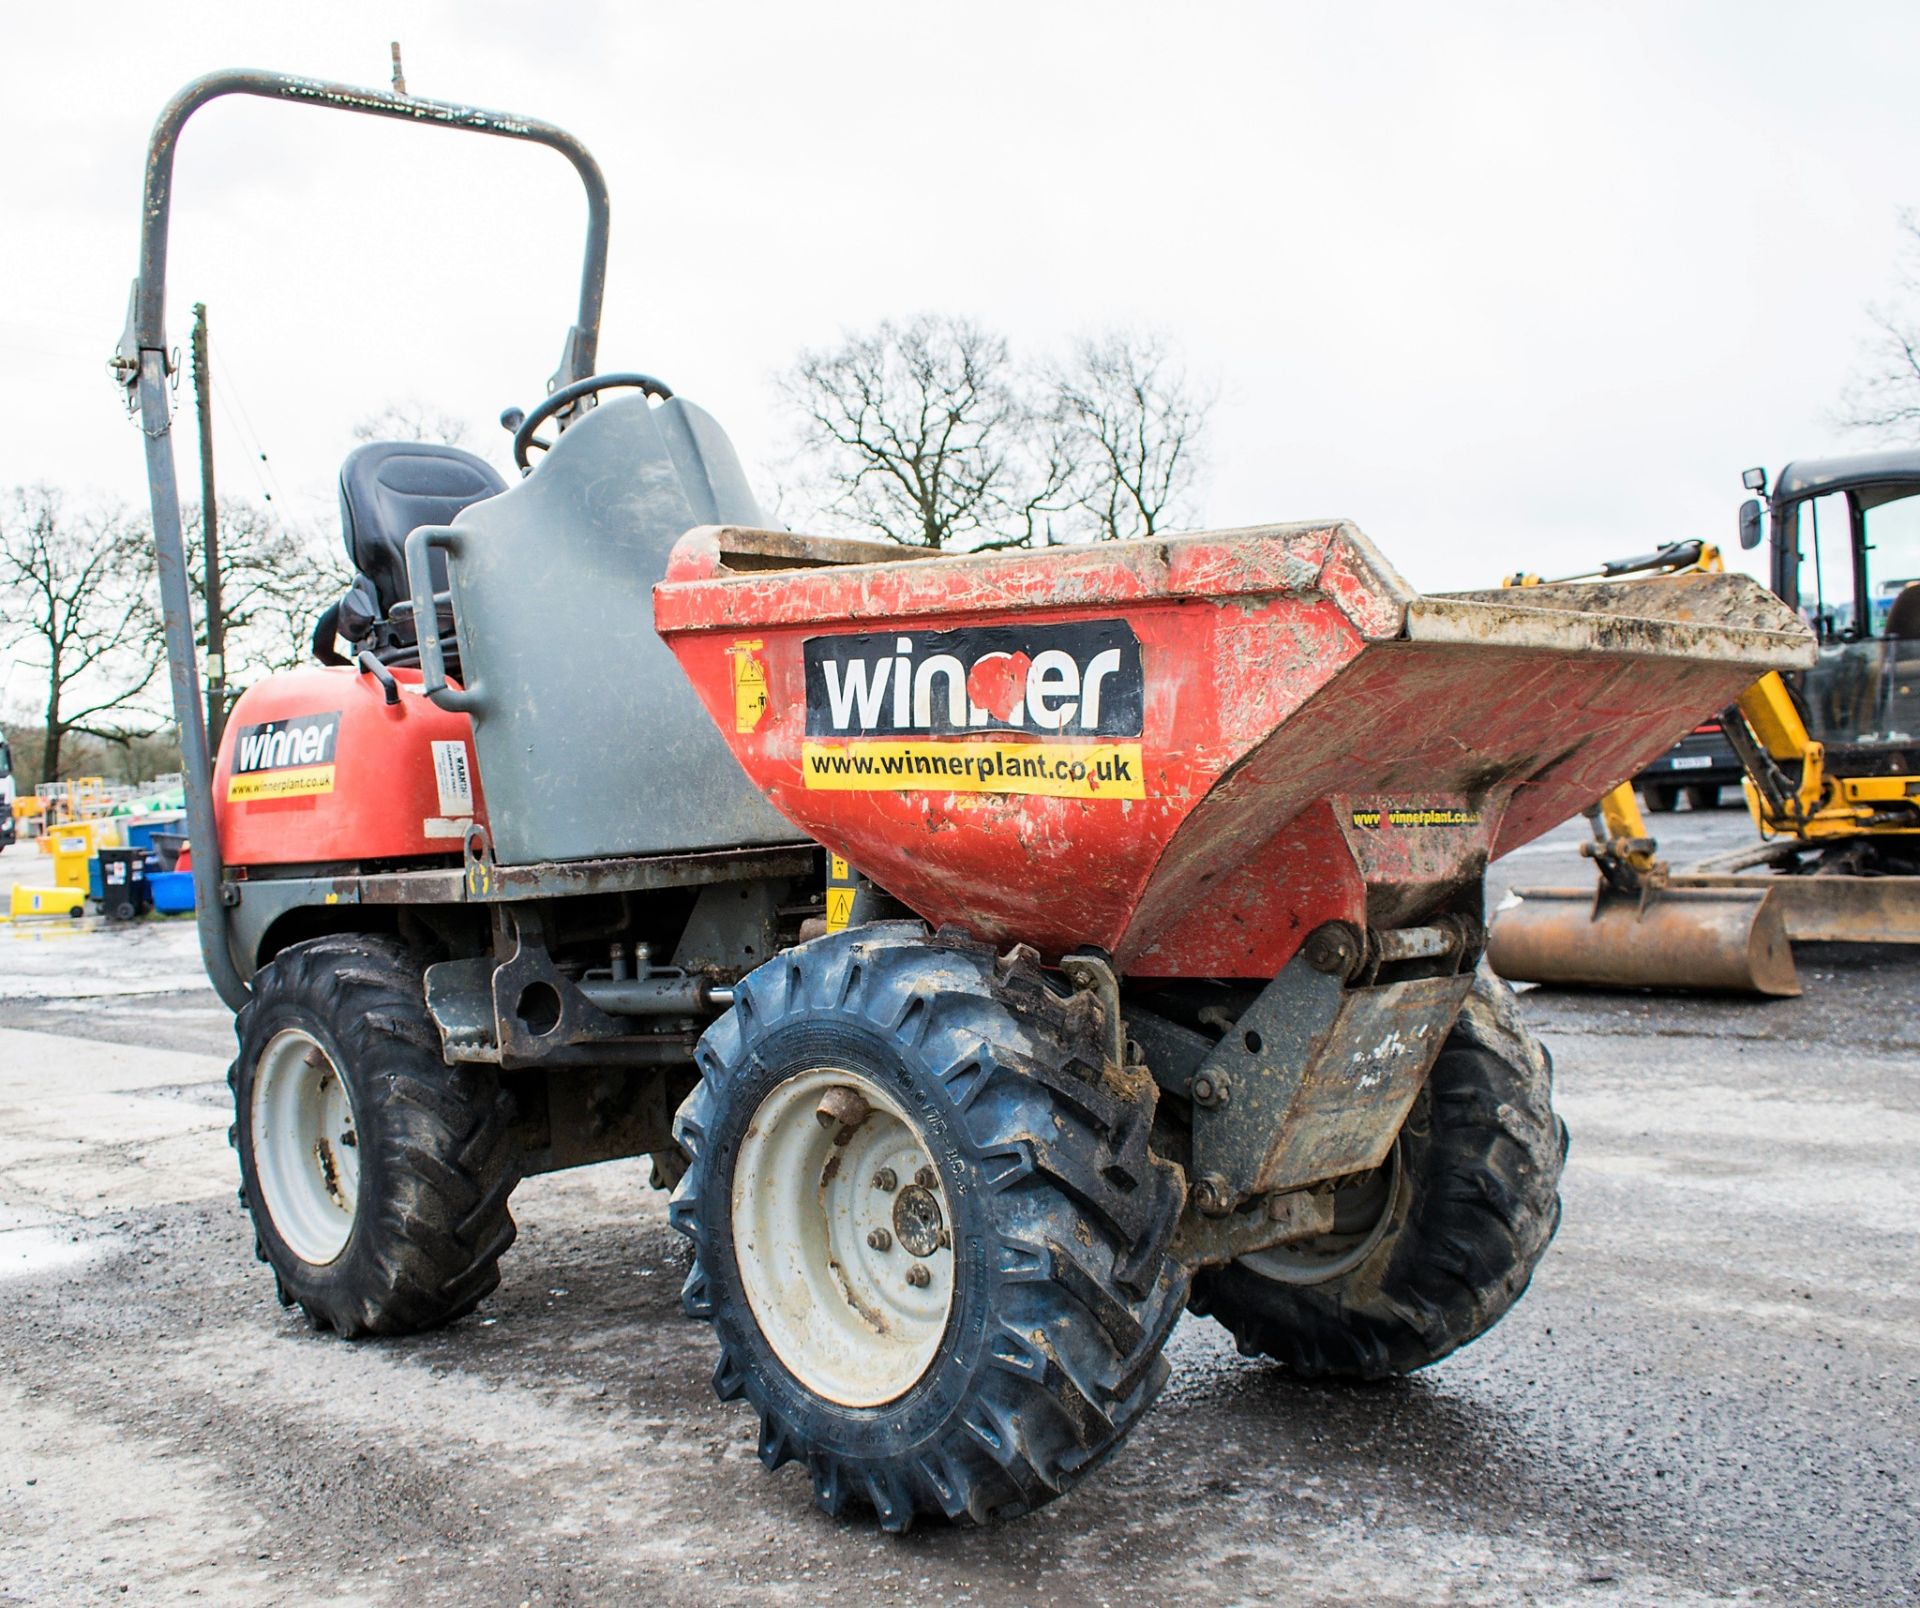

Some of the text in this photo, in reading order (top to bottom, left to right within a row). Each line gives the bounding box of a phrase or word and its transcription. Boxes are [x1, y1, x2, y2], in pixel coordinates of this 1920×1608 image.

[240, 724, 334, 771] winner
[811, 750, 1132, 782] www.winnerplant.couk
[231, 774, 330, 795] www.winnerplant.co.uk
